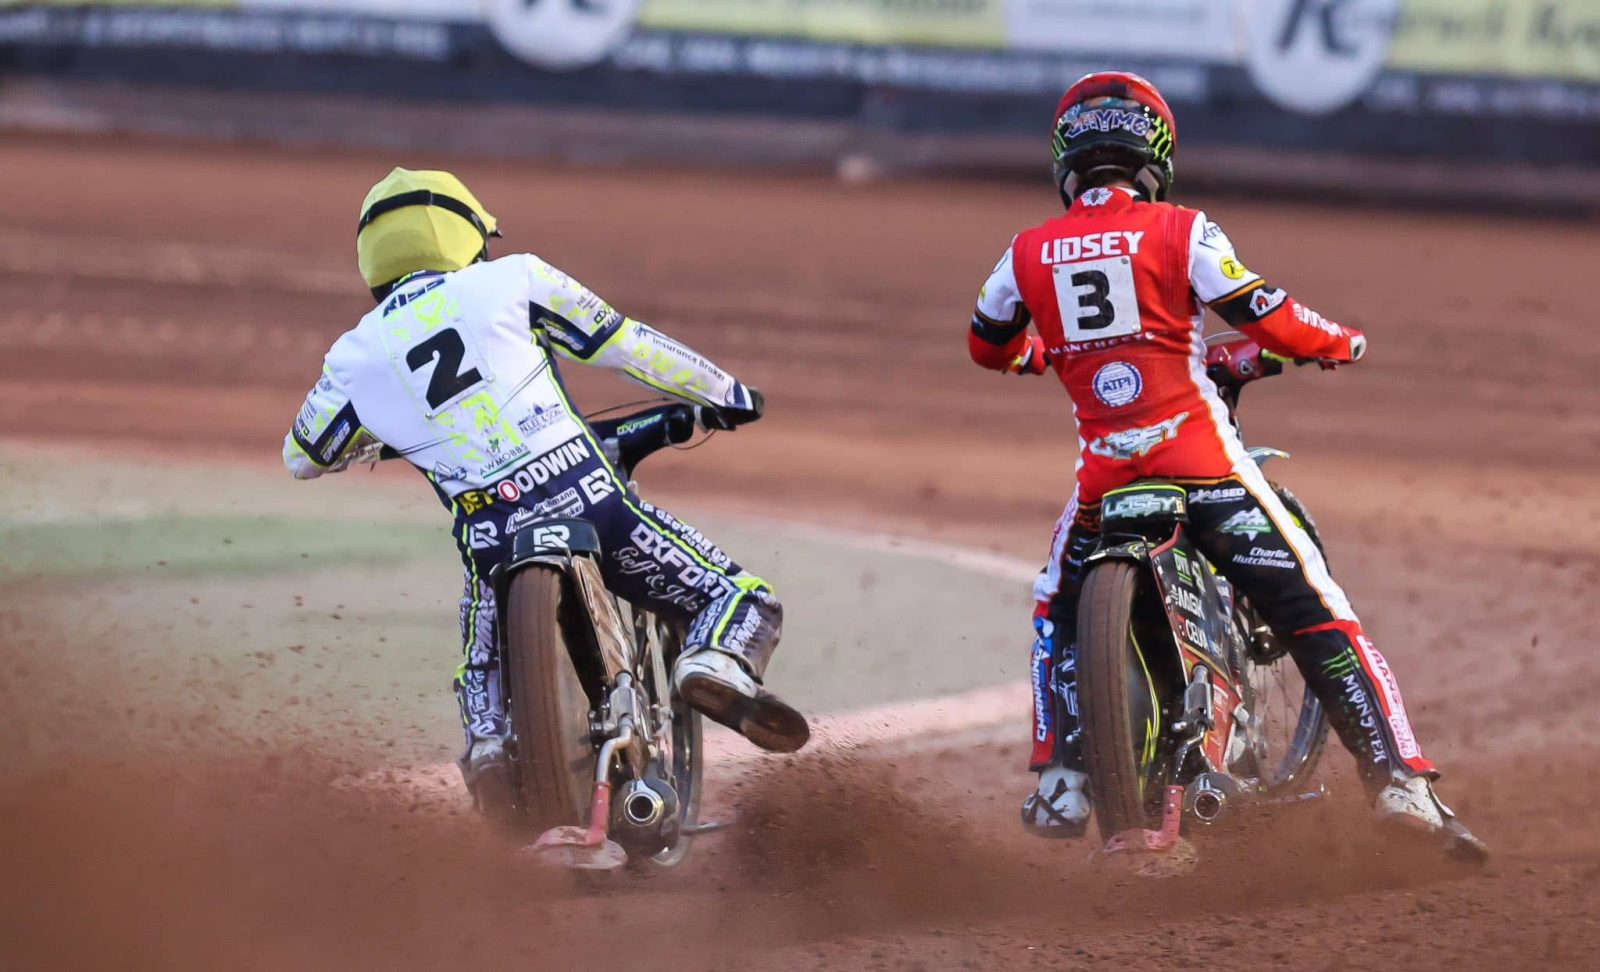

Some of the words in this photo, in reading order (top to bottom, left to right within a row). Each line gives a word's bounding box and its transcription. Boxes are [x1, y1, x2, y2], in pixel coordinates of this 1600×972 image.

[1041, 231, 1143, 265] LIDSEY
[1071, 269, 1115, 330] 3
[406, 327, 482, 410] 2
[1232, 554, 1296, 569] Hutchinson
[1249, 547, 1289, 559] Charlie
